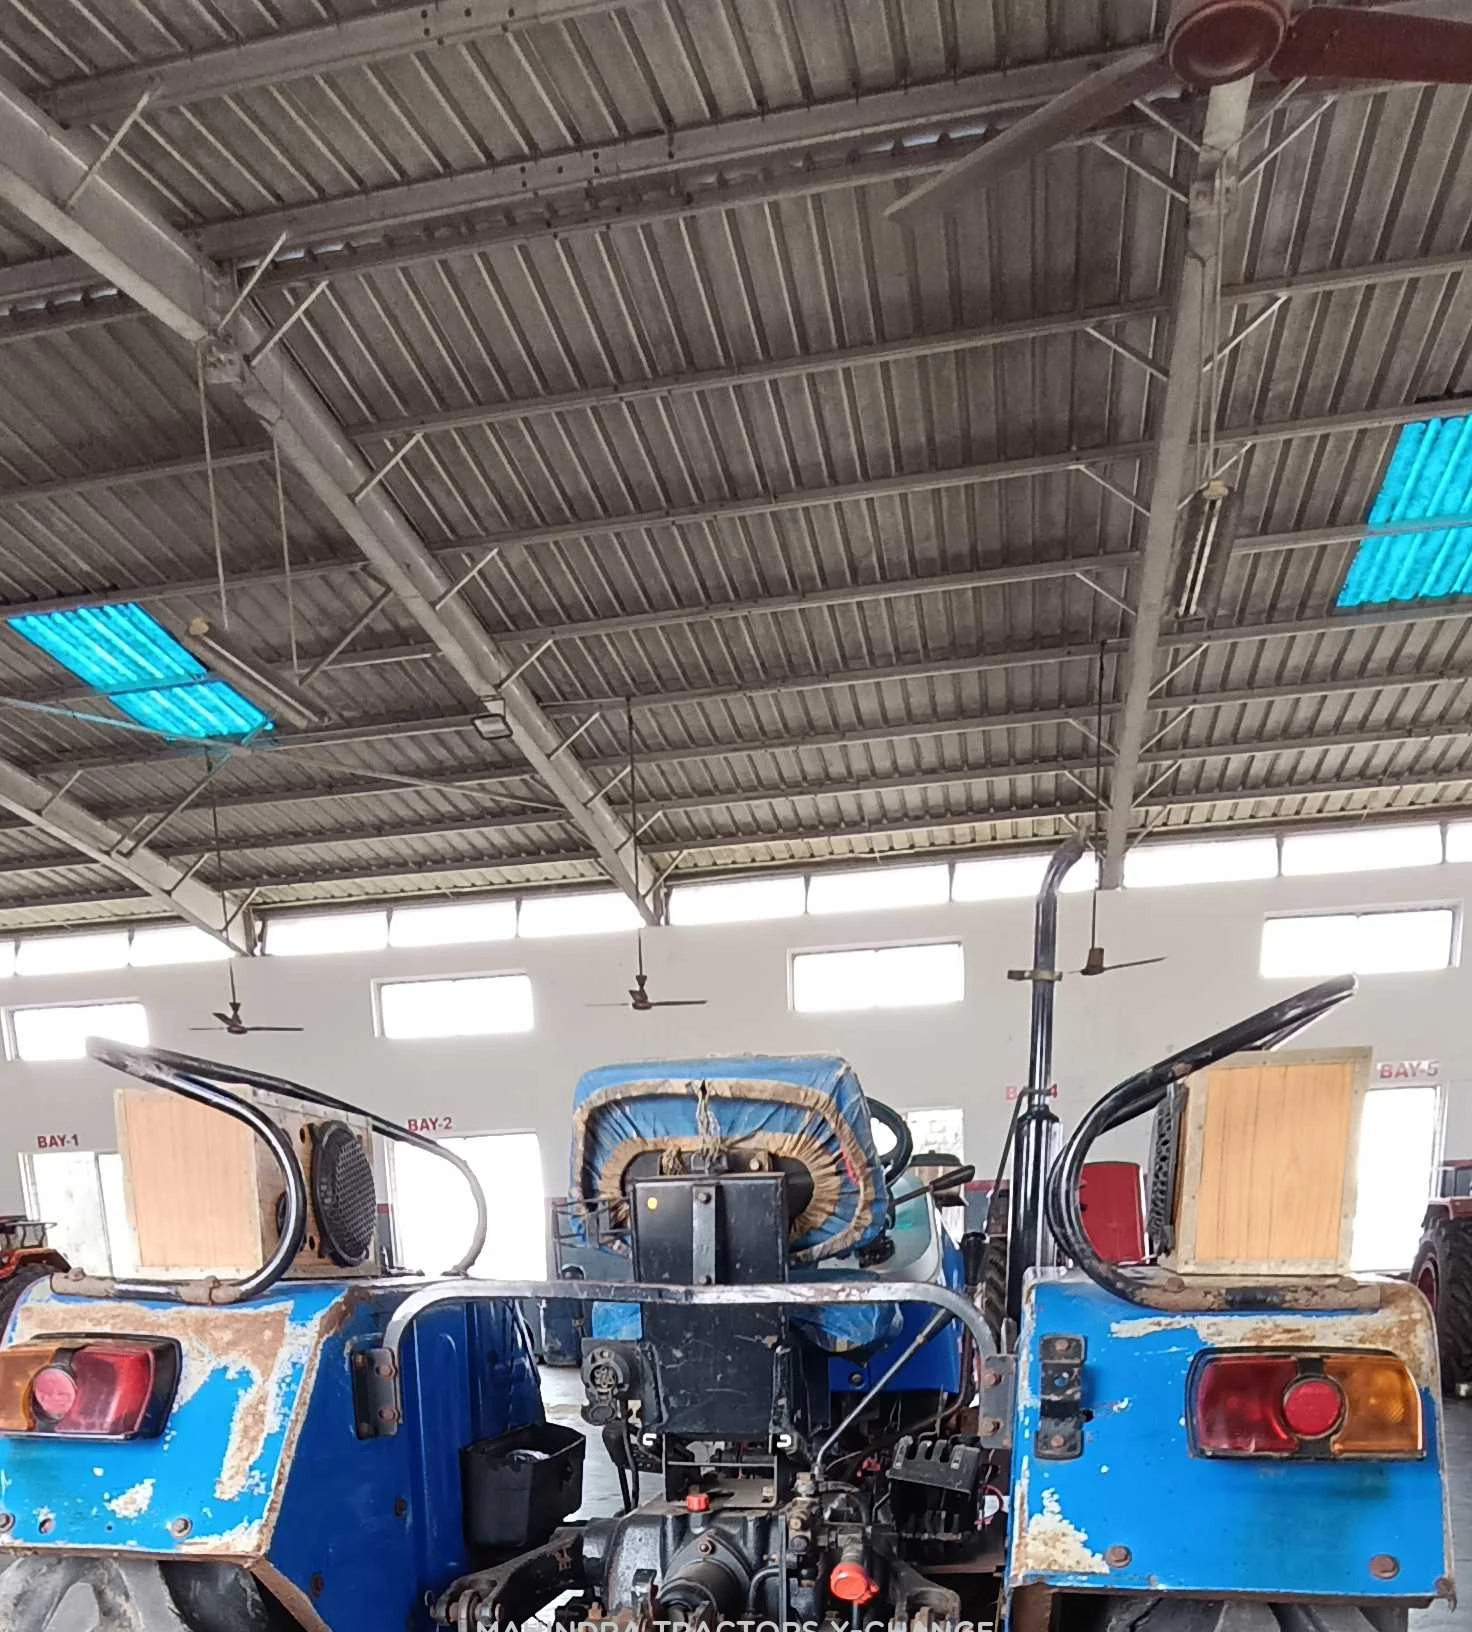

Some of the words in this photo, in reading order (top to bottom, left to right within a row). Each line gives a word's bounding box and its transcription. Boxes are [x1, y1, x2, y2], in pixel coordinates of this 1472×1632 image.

[1379, 1060, 1439, 1079] BAY-5
[407, 1116, 453, 1131] BAY-2
[37, 1133, 79, 1149] BAY-1
